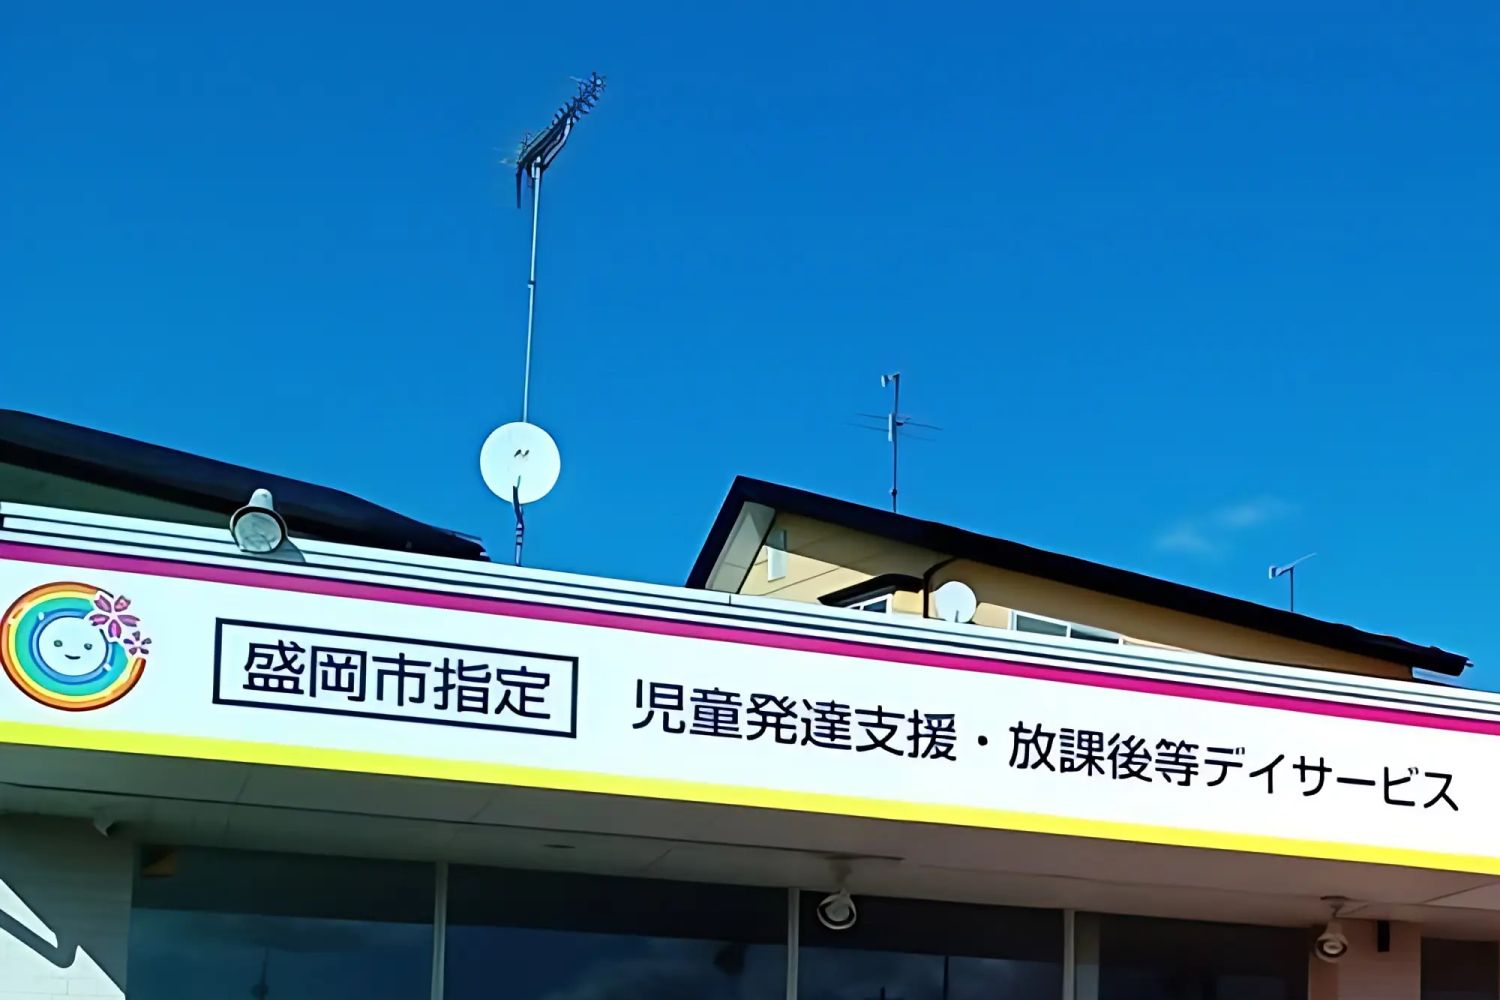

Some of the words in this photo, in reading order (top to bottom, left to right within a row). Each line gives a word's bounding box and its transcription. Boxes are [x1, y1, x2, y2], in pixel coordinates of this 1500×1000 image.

[242, 640, 552, 721] 盛岡市指定
[632, 678, 1460, 812] 児童発達支援・放課後等デイサービス
